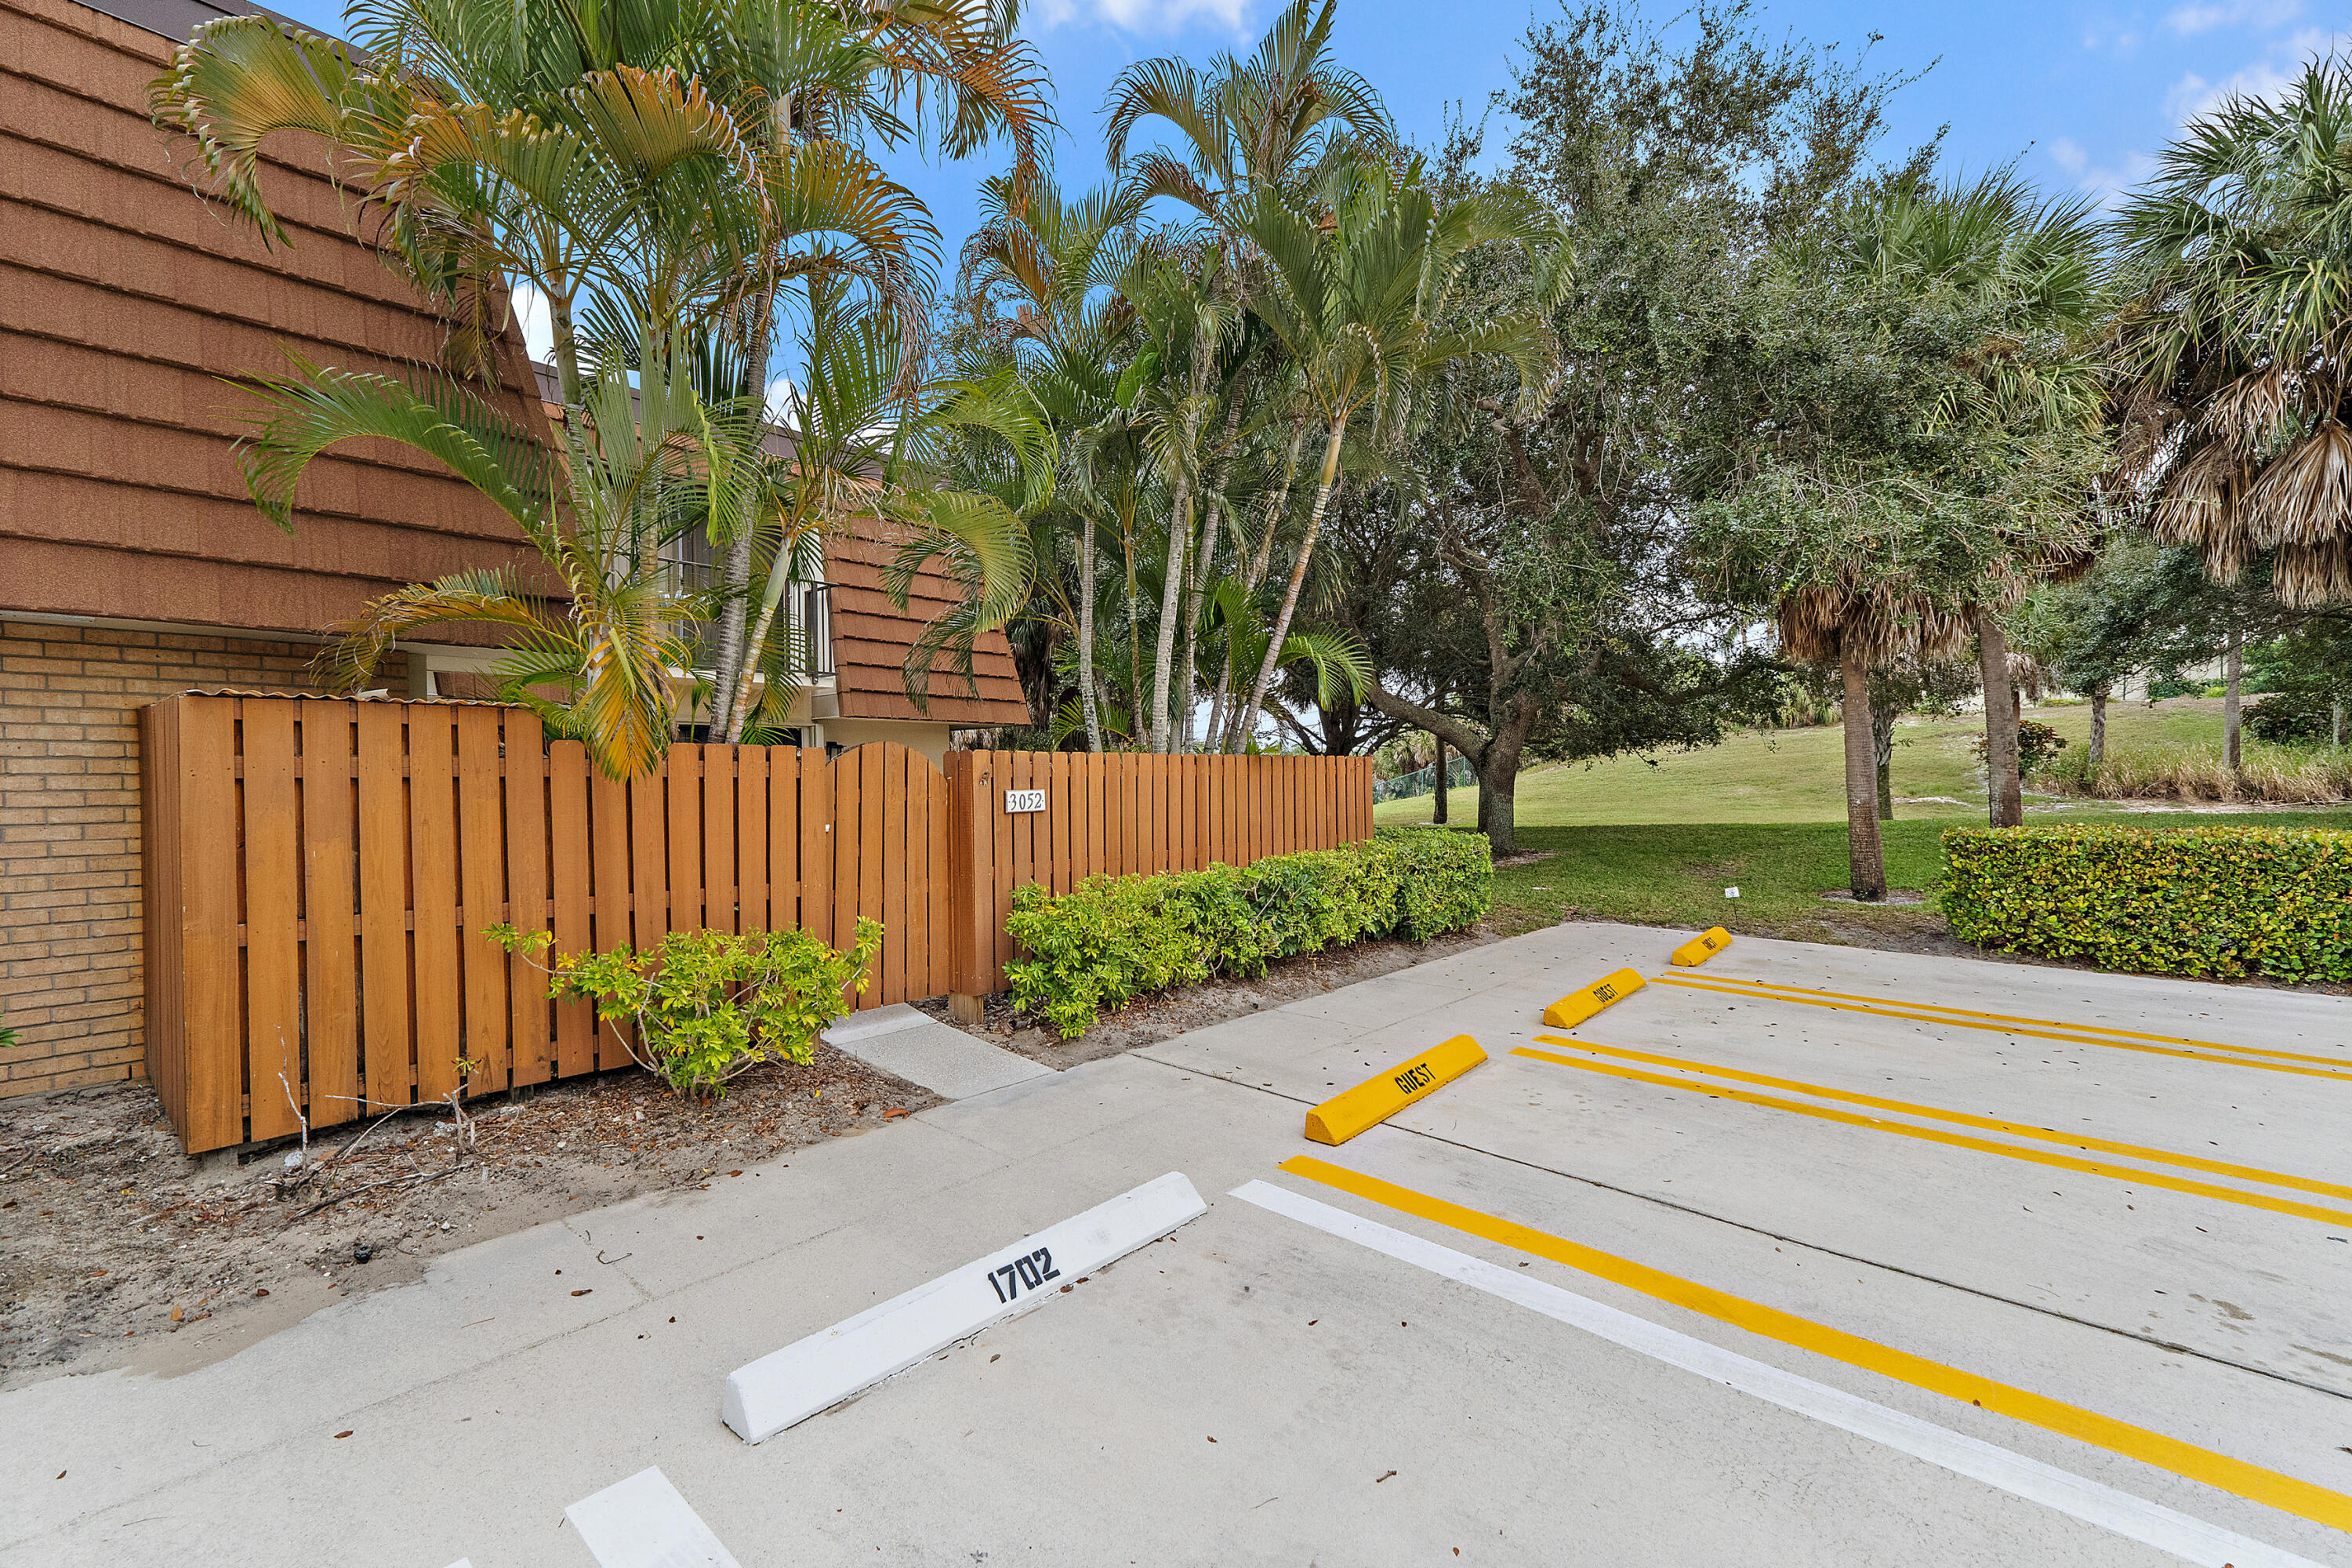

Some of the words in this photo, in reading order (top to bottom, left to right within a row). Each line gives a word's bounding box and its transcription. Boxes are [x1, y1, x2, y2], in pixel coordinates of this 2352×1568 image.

[1010, 793, 1042, 811] 3052
[1592, 983, 1619, 1003] GUEST
[1394, 1062, 1436, 1094] GUEST
[987, 1247, 1061, 1304] 1702
